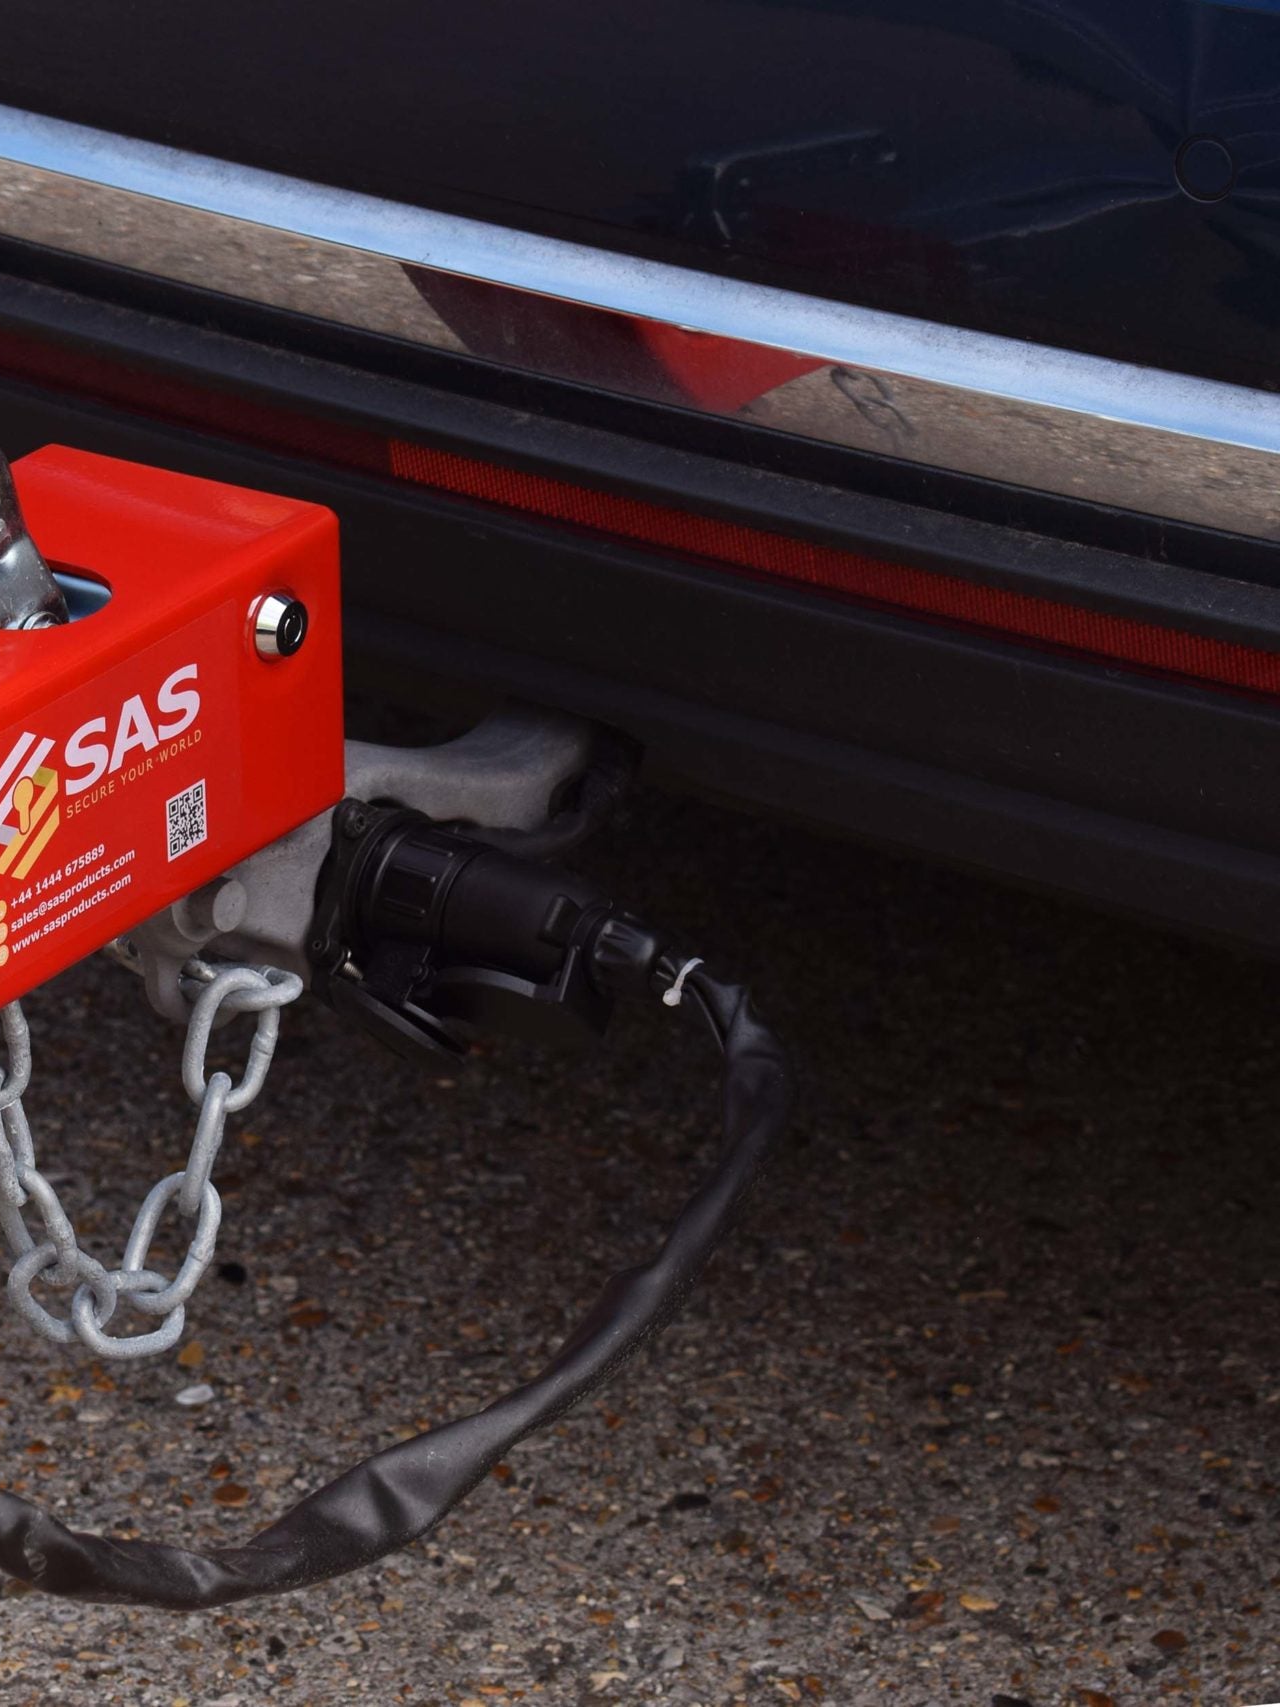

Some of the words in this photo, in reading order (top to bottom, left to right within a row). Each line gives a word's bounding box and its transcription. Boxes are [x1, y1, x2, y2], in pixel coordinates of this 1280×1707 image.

[64, 663, 201, 796] SAS
[66, 780, 115, 819] SECURE
[120, 758, 154, 786] YOUR
[159, 729, 202, 764] WORLD
[10, 887, 32, 909] +44
[35, 869, 62, 896] 1444
[65, 843, 105, 877] 675889
[10, 849, 136, 933] sales@sasproducts.com
[11, 873, 132, 954] www.sasproducts.com
